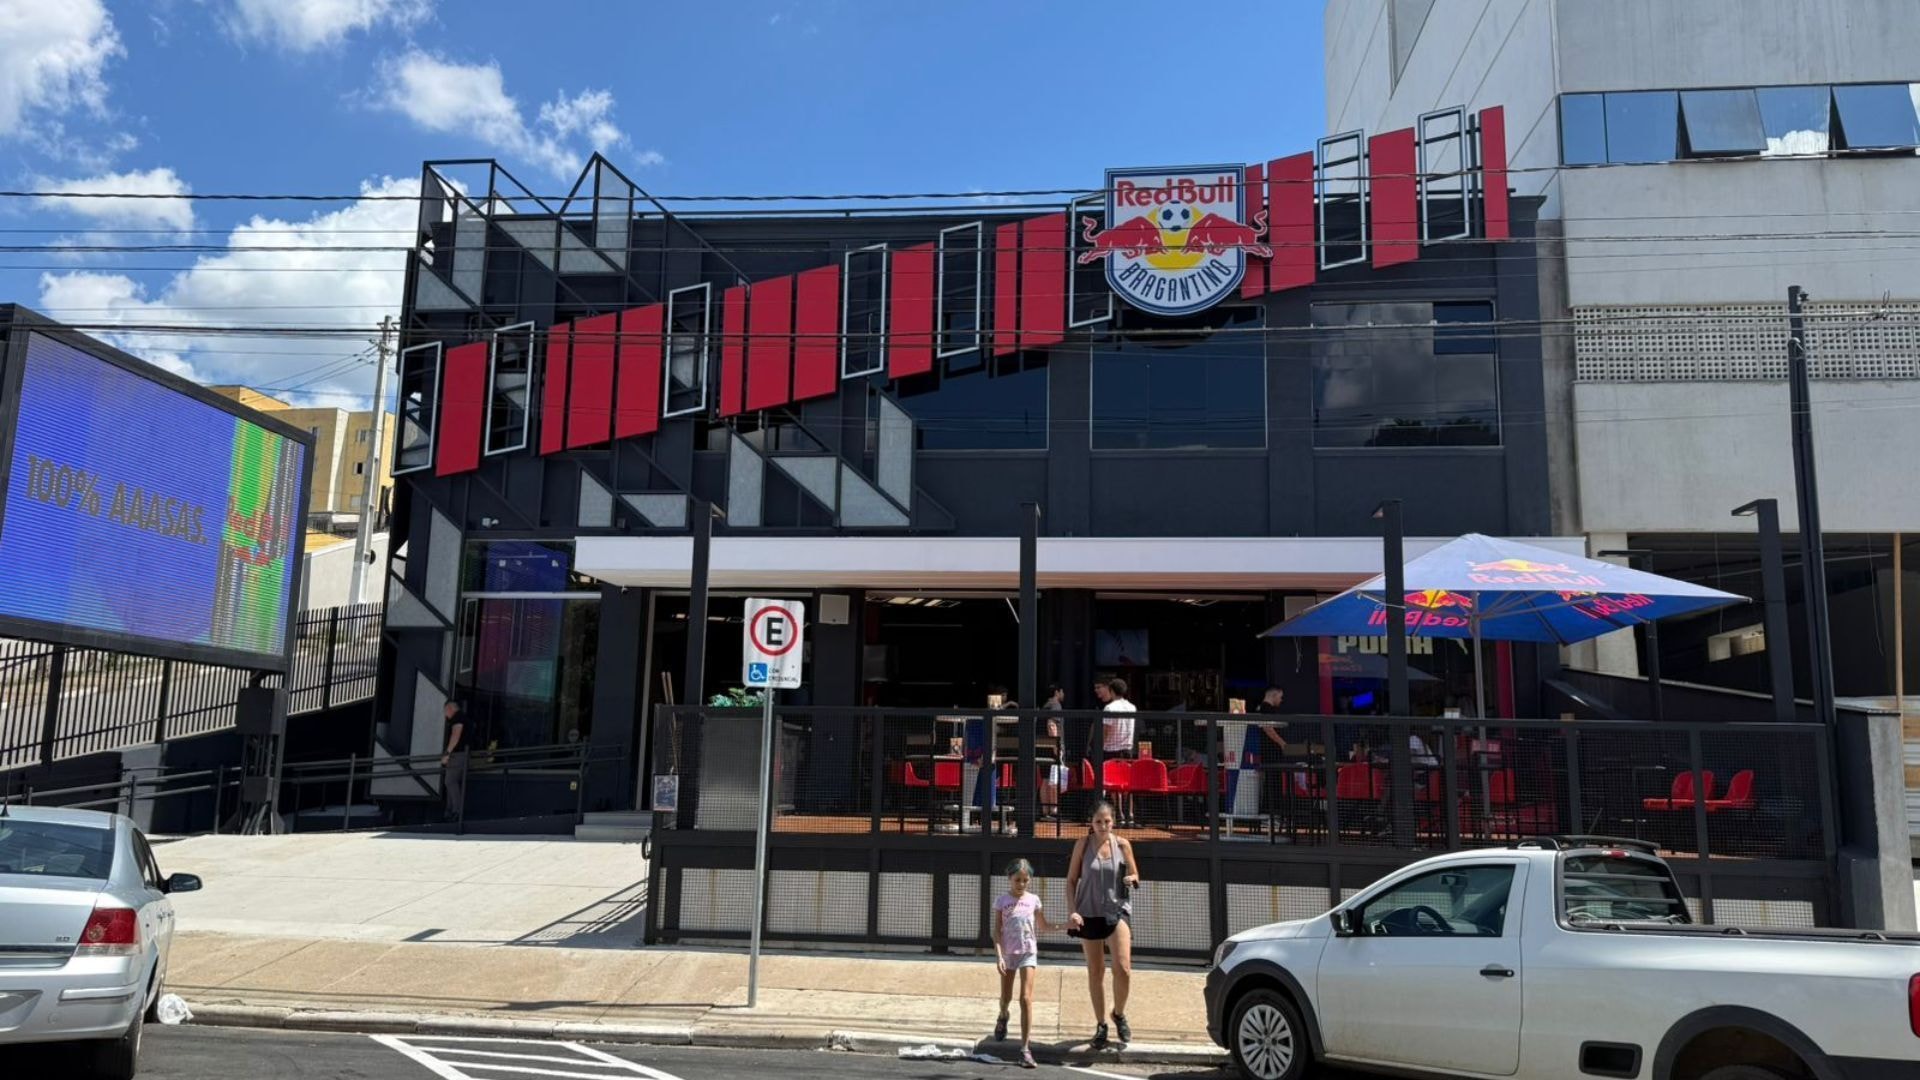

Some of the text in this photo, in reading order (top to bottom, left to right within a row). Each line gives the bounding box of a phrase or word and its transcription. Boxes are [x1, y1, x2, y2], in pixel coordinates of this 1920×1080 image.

[1117, 176, 1234, 206] Red Bull
[1119, 259, 1232, 302] BRAGANTINO
[27, 454, 101, 516] 100%
[1469, 572, 1606, 587] Red Bull
[767, 618, 784, 645] E
